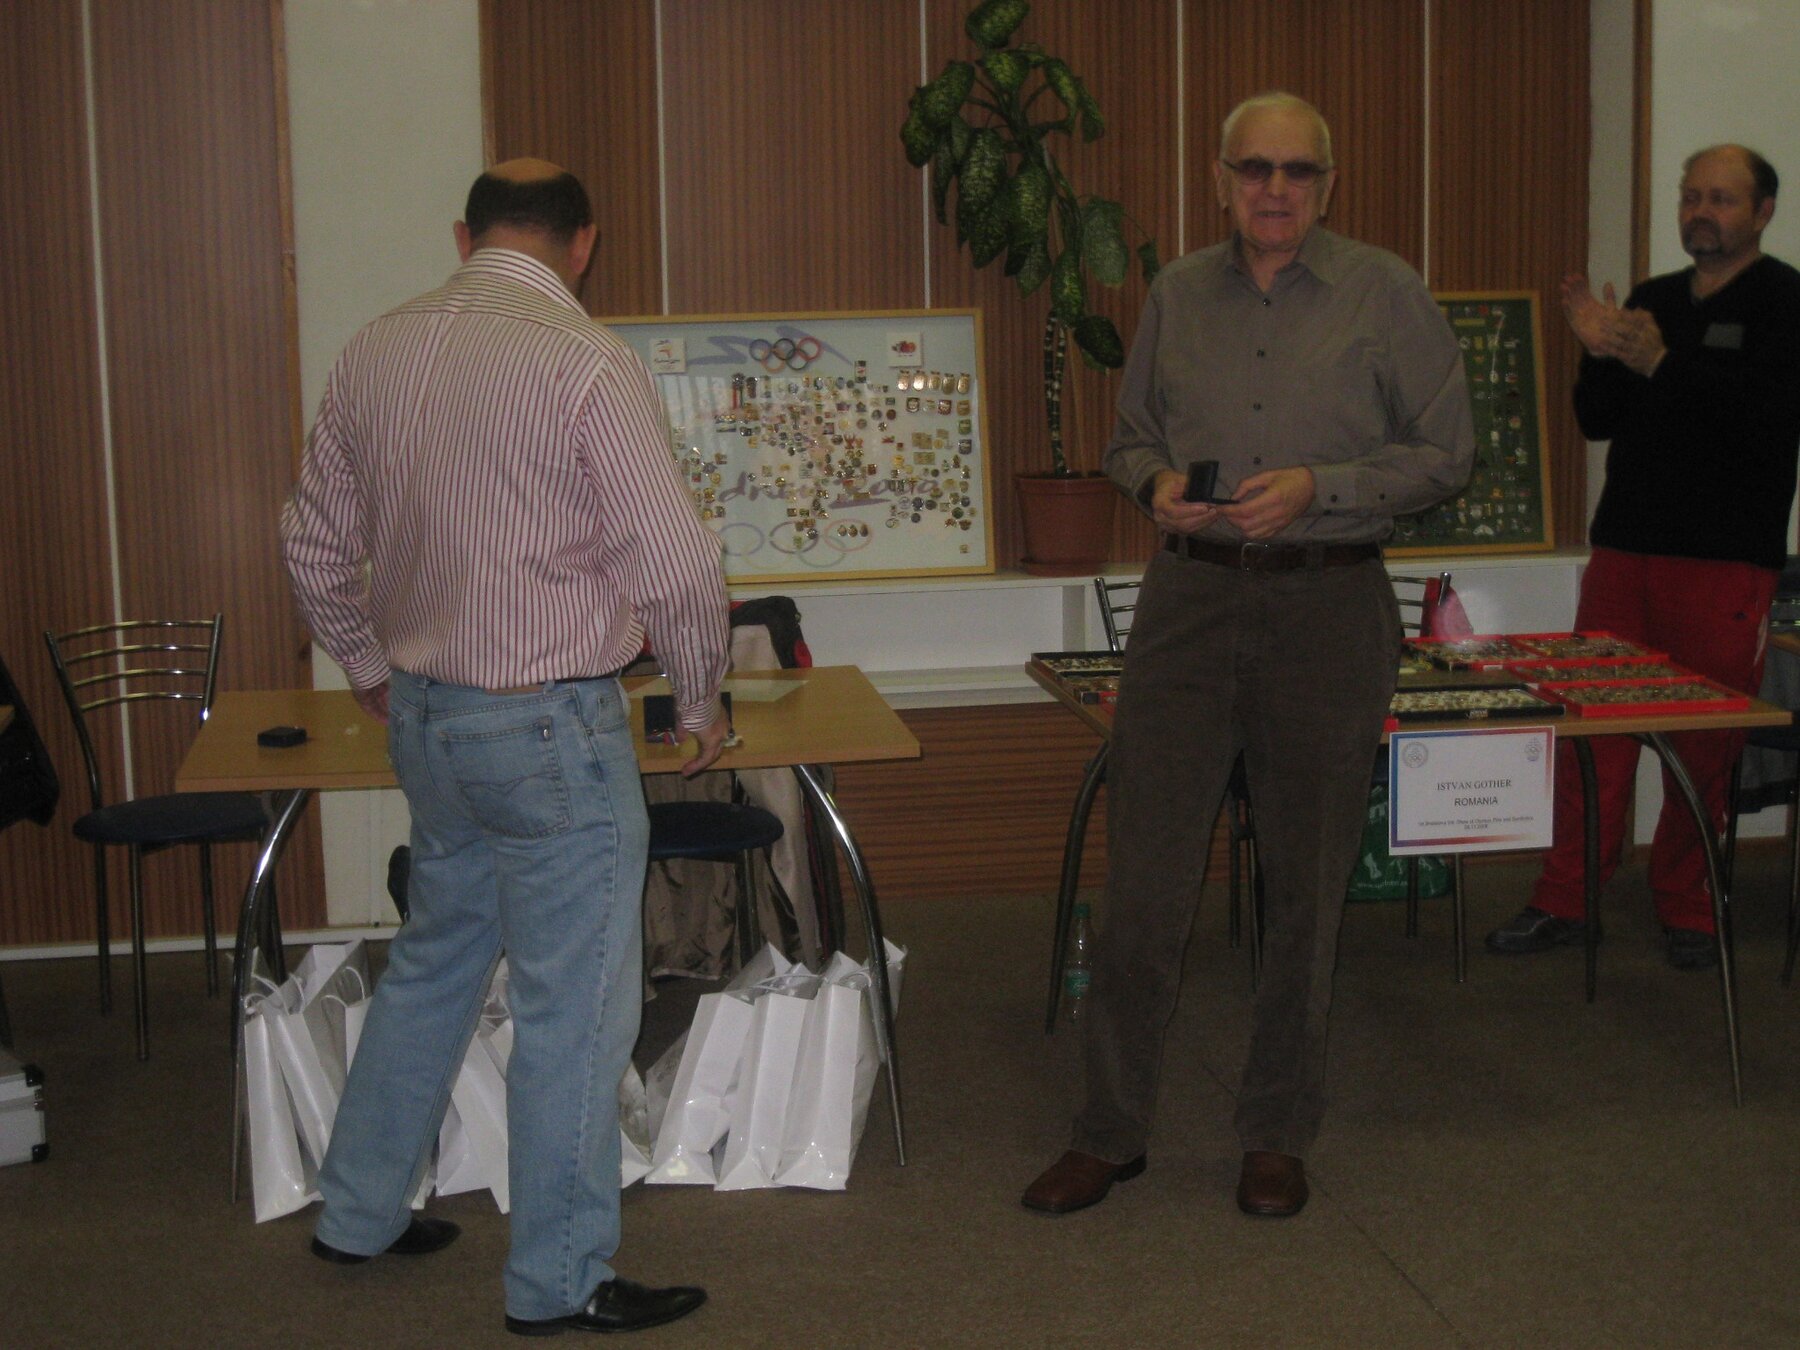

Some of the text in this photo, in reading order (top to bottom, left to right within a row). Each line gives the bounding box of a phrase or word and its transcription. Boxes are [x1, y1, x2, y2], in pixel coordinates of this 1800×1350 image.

[1437, 779, 1512, 791] ISTVAN GOTHER
[1454, 796, 1498, 806] ROMANIA
